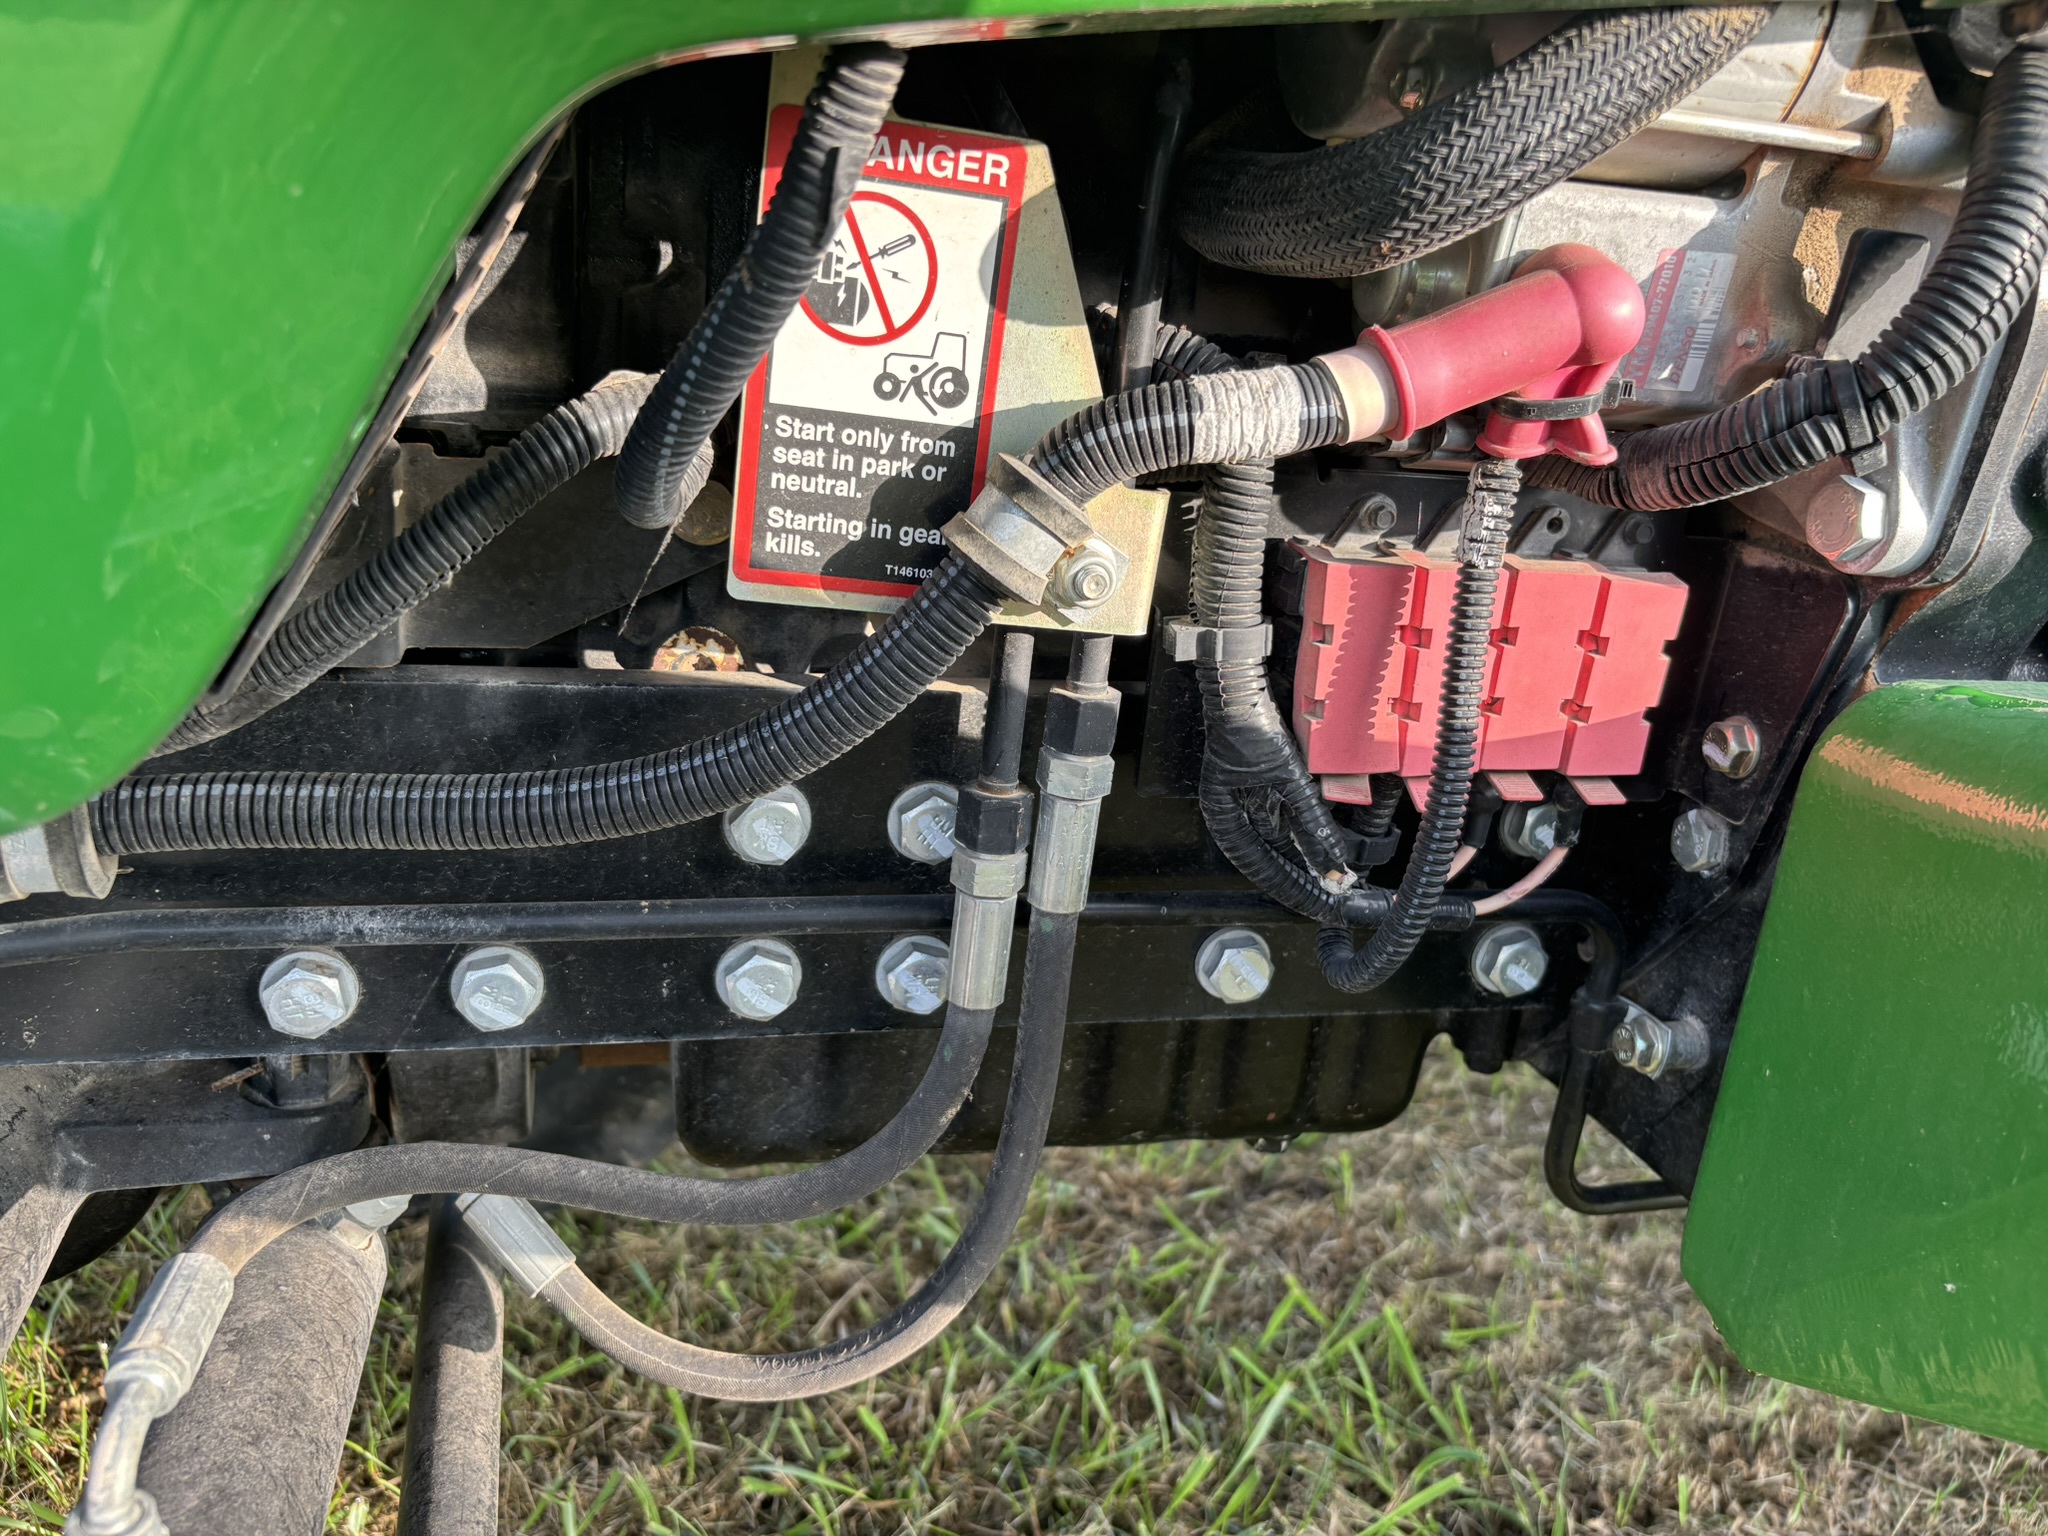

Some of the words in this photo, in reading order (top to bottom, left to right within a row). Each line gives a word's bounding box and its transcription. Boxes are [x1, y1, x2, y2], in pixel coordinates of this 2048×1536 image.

[867, 136, 1010, 187] ANGER
[1698, 289, 1707, 306] MADE
[1668, 325, 1696, 384] DENSO
[775, 415, 834, 443] Start
[841, 427, 894, 454] only
[900, 431, 956, 457] from
[772, 446, 826, 468] seat
[832, 449, 854, 471] in
[861, 457, 915, 478] park
[921, 464, 947, 482] or
[771, 472, 862, 498] neutral.
[767, 506, 863, 541] Starting
[870, 518, 891, 539] in
[765, 531, 821, 557] kills.
